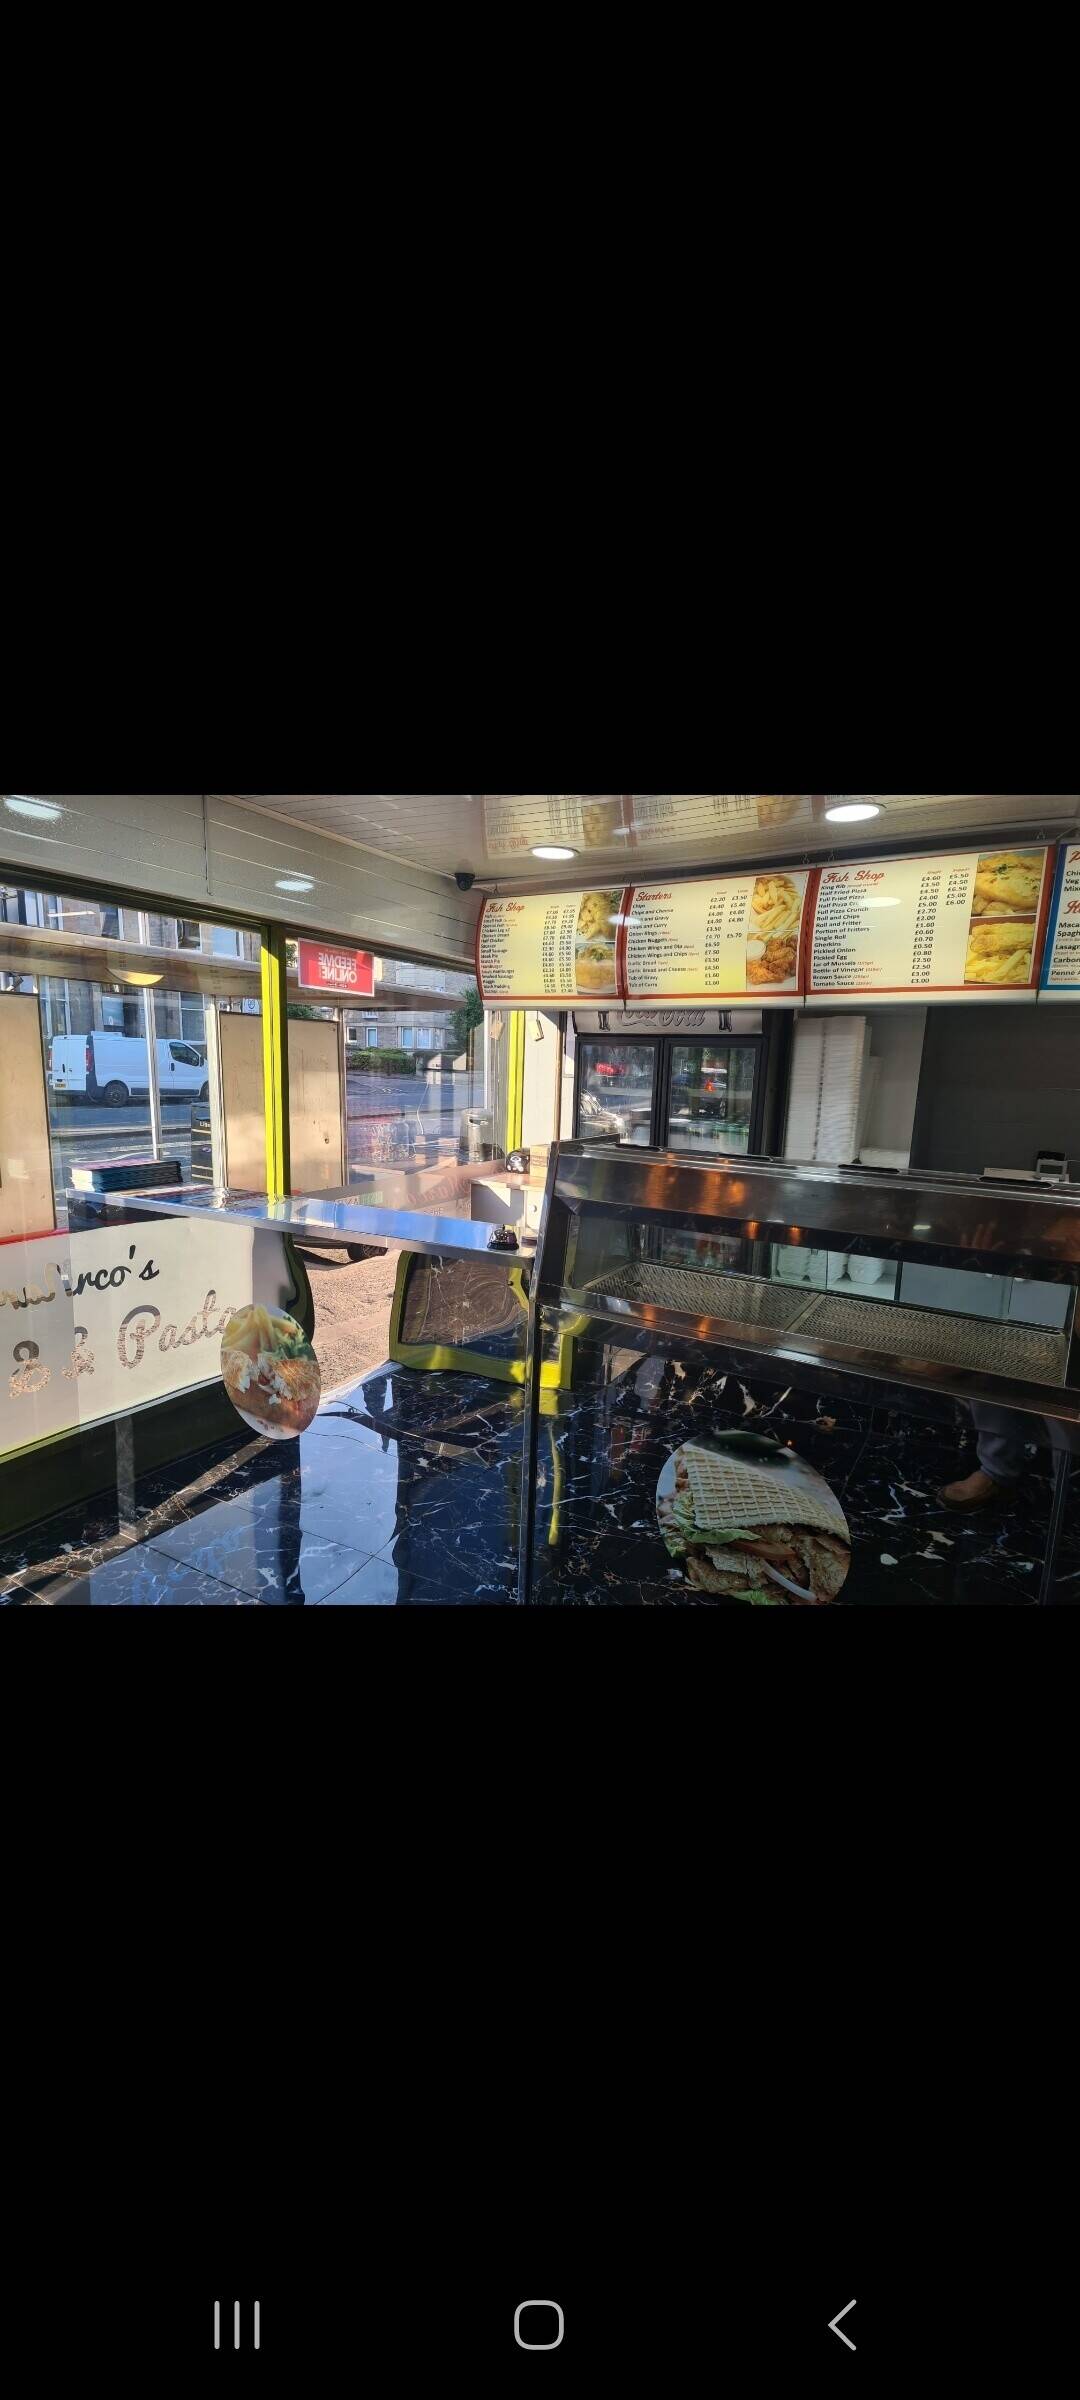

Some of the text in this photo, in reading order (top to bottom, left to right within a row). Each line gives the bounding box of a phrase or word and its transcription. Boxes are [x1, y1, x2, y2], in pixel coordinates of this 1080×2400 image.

[823, 870, 886, 883] Fish Shop
[636, 891, 672, 901] Starters
[486, 902, 525, 913] Fish Shop
